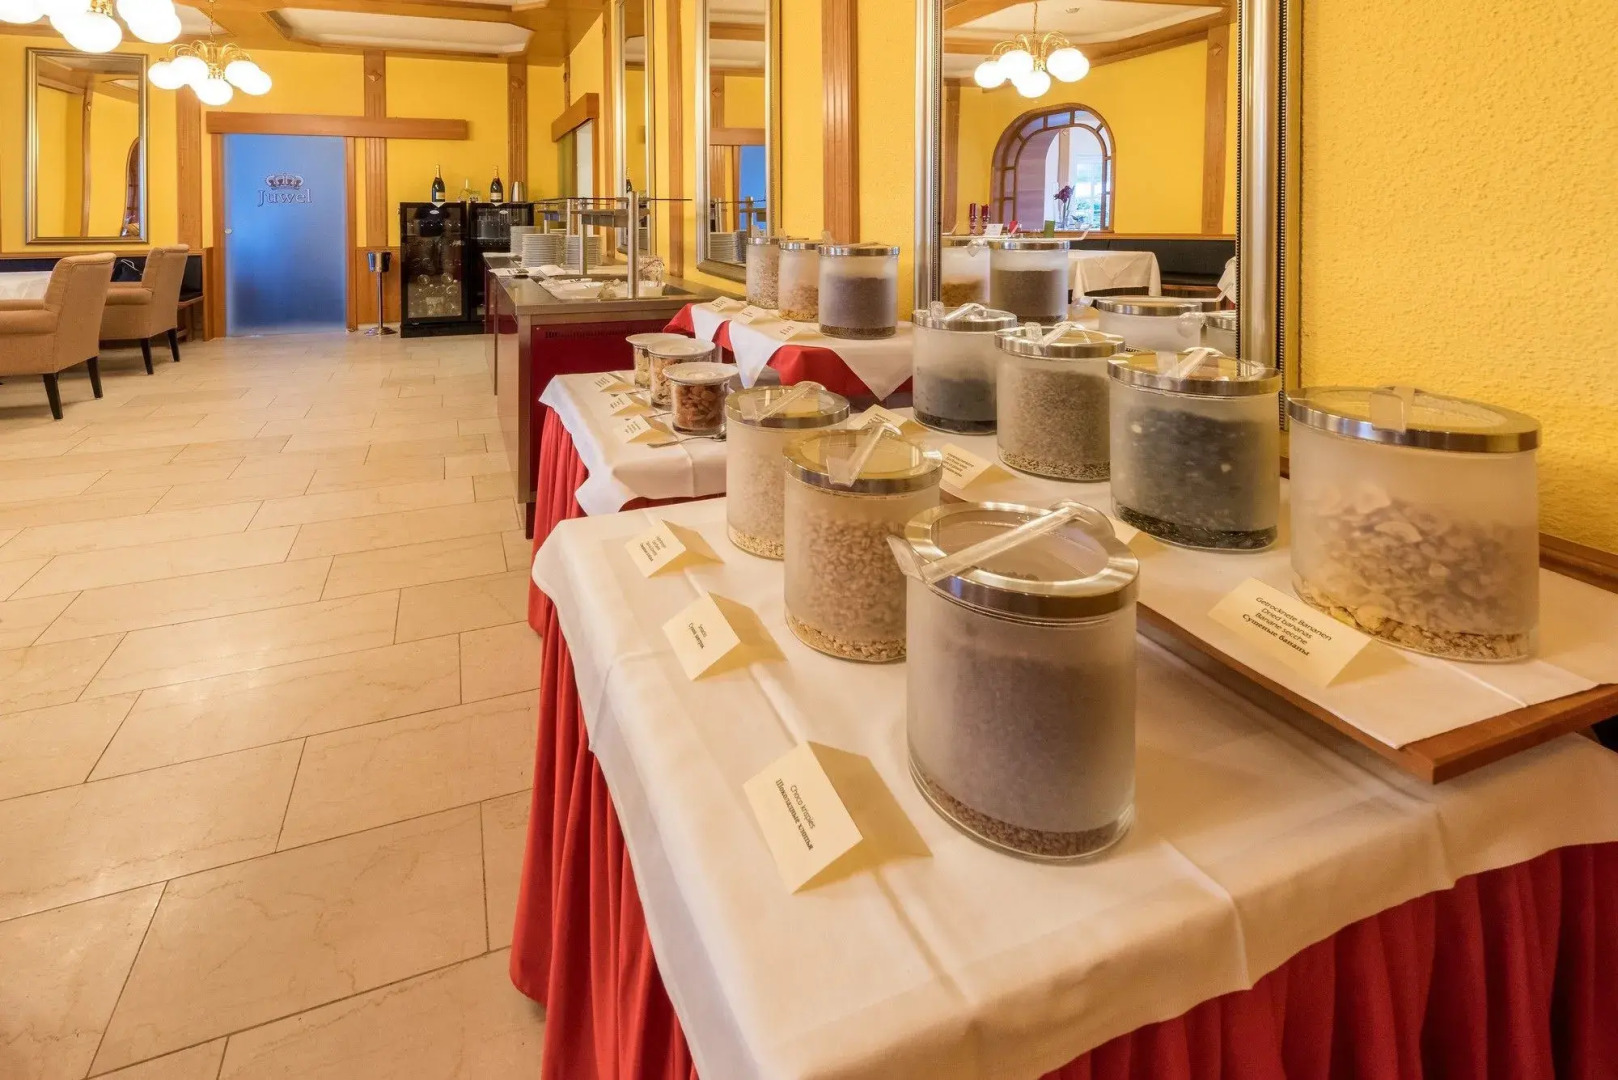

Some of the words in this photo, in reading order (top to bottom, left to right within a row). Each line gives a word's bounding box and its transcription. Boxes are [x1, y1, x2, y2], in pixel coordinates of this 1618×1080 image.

[257, 188, 312, 207] Juwel
[1255, 597, 1298, 622] Getrocknete
[1298, 620, 1332, 641] Bananen
[1255, 612, 1282, 630] Banane
[1282, 628, 1308, 645] secche
[1261, 608, 1281, 621] Dried
[1281, 619, 1312, 639] bananas
[1278, 635, 1310, 656] бананы
[790, 785, 803, 806] Choco
[801, 804, 816, 829] krispies
